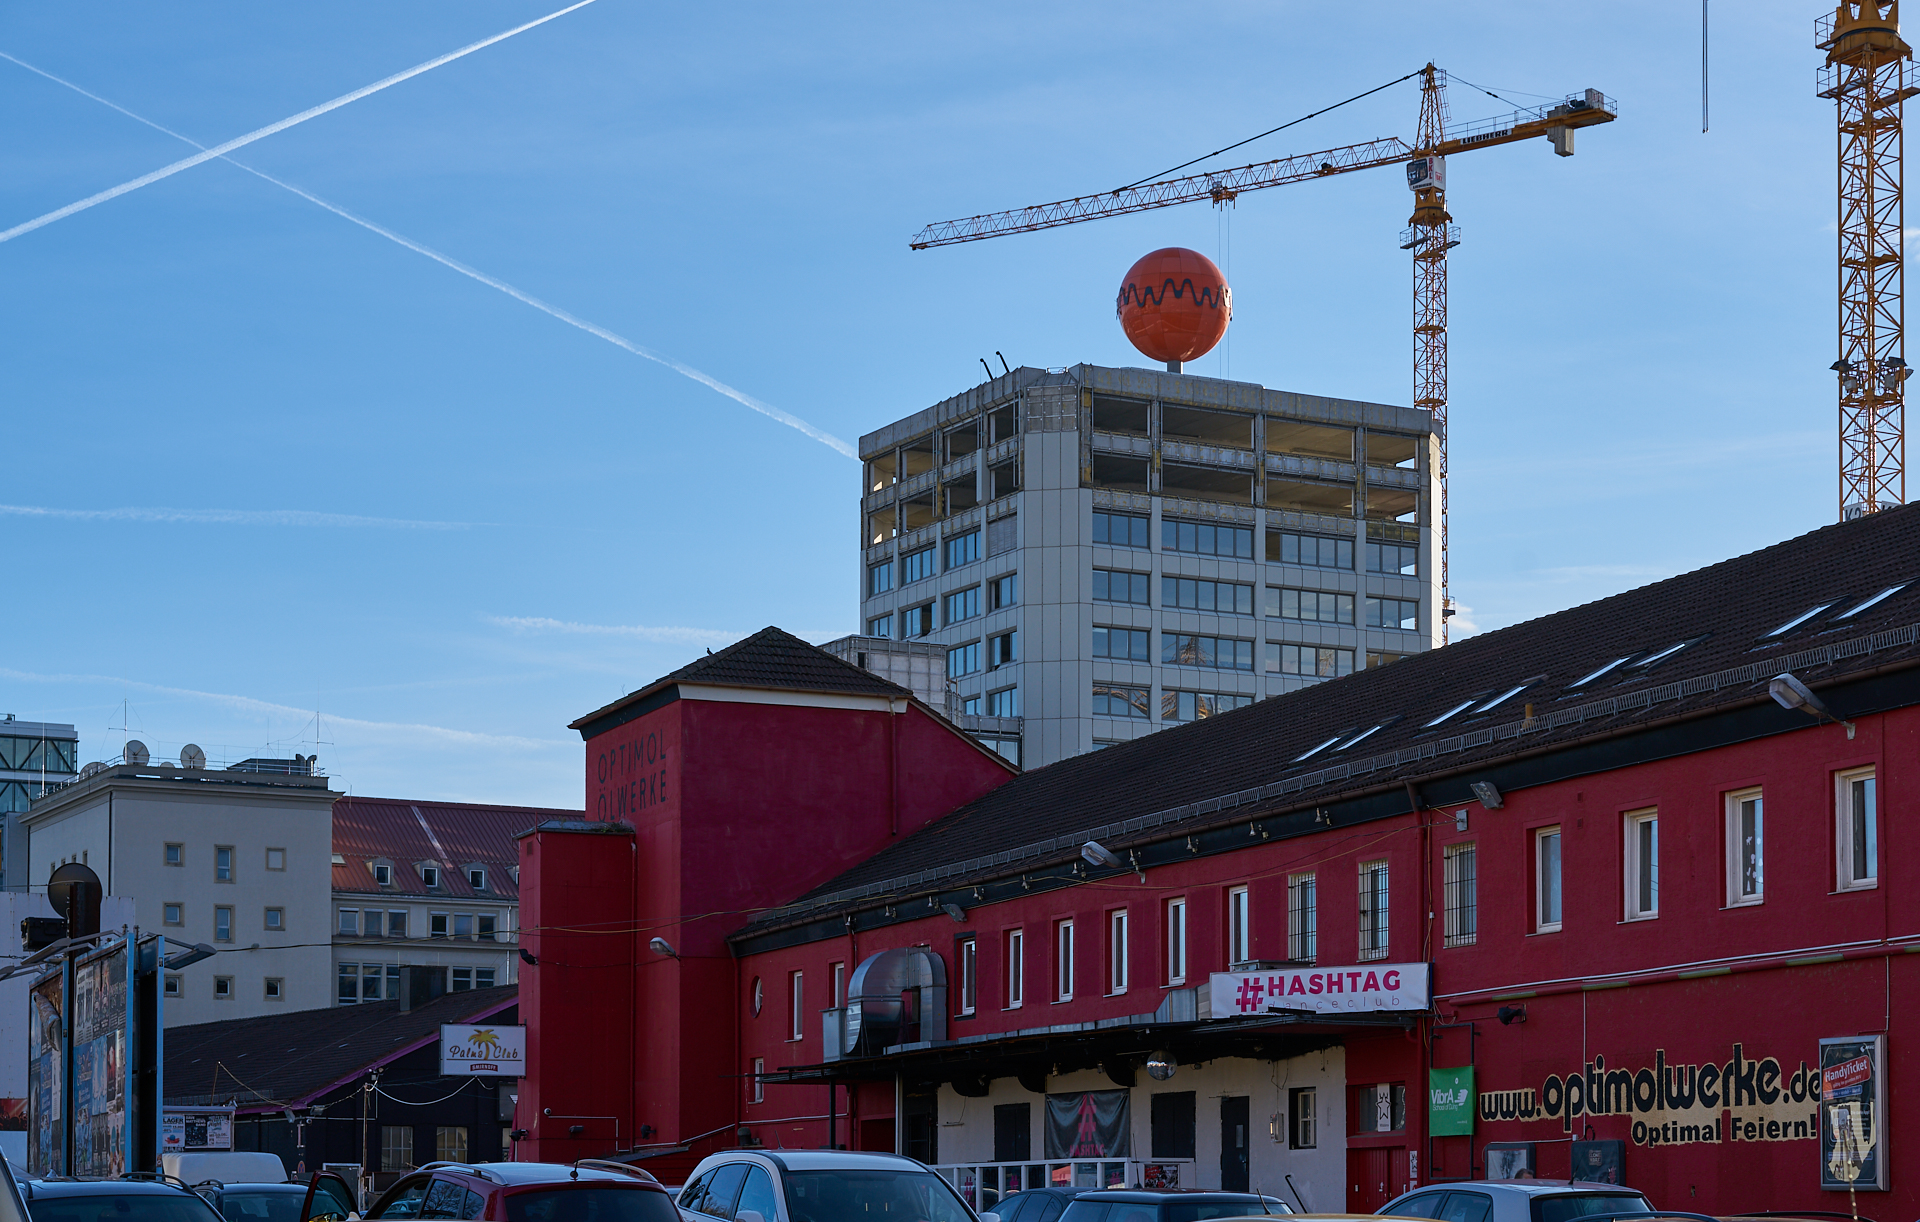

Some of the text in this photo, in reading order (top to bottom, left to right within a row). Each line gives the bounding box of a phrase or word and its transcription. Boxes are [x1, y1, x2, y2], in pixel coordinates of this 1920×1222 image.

[1462, 129, 1509, 144] LIEBHERR
[598, 729, 667, 784] OPTIMOL
[598, 769, 667, 822] ÖLWERKE
[449, 1045, 518, 1059] Palms Club
[1825, 1059, 1868, 1082] HandyTicket
[1431, 1088, 1454, 1104] VibrA
[1632, 1114, 1817, 1148] Optimal Feiern!
[1069, 1143, 1105, 1157] HASHTAG
